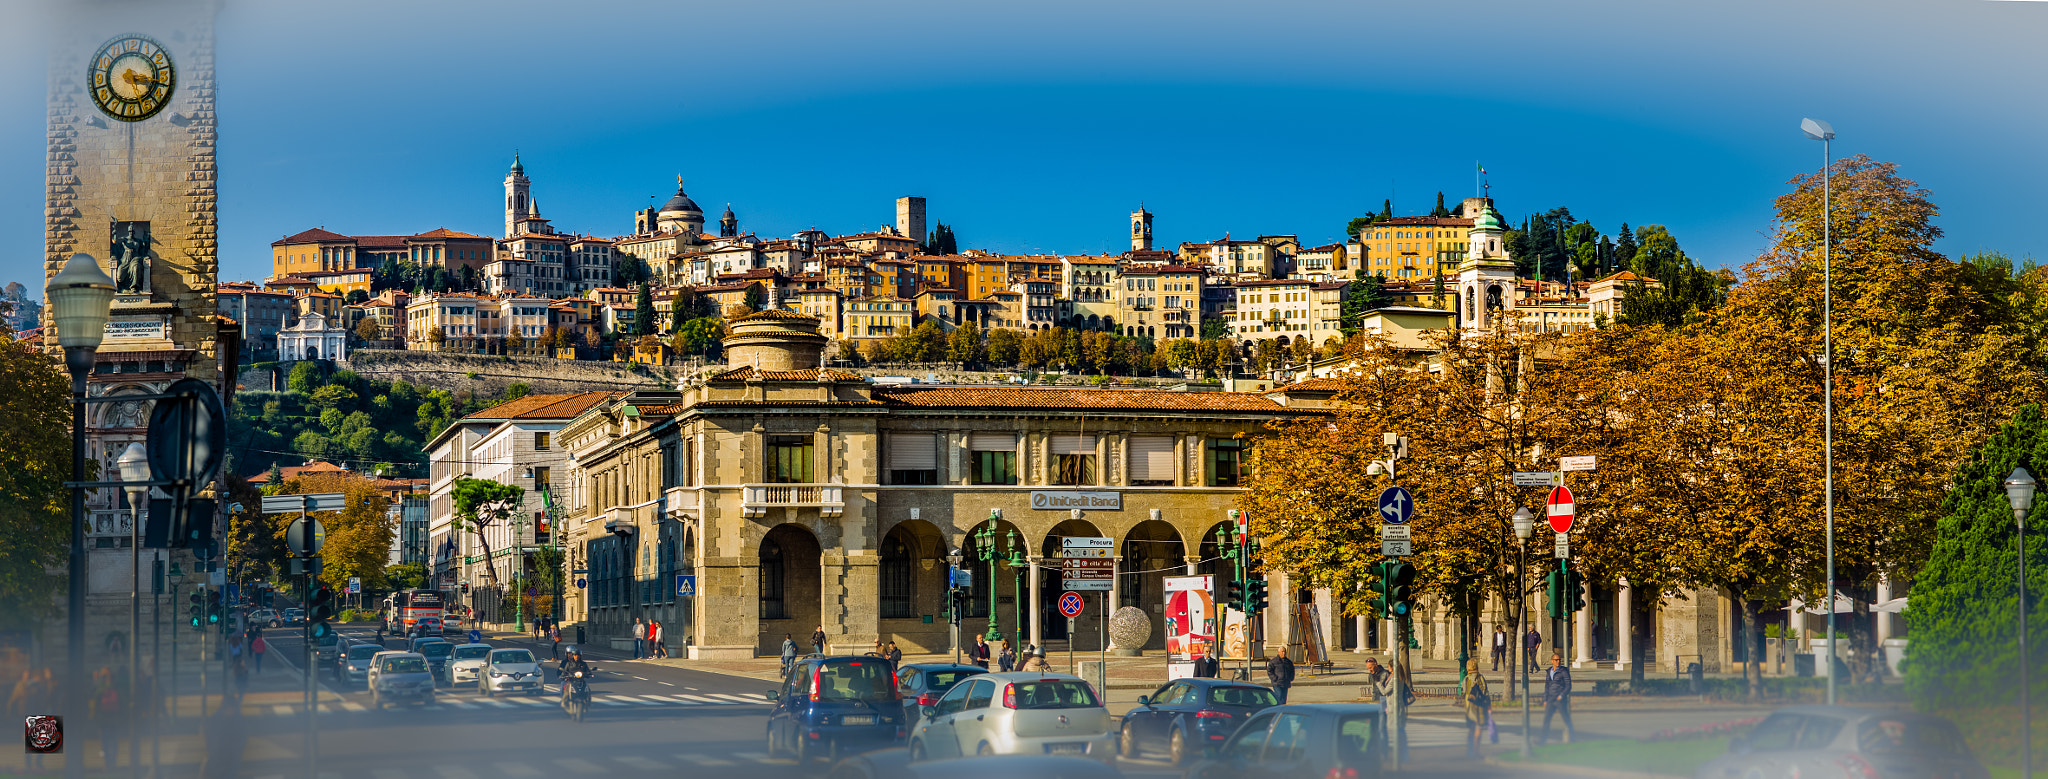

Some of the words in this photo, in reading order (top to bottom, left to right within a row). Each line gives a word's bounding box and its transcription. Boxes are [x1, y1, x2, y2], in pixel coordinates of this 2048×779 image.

[110, 44, 120, 55] 11
[125, 40, 137, 50] 12
[144, 44, 149, 54] 1
[98, 57, 110, 68] 10
[154, 54, 163, 64] 2
[95, 73, 102, 84] 9
[160, 70, 168, 82] 3
[100, 88, 107, 100] 8
[154, 88, 162, 98] 4
[112, 100, 119, 112] 7
[128, 104, 135, 115] 6
[144, 100, 152, 110] 5
[1049, 496, 1090, 506] UniCredit
[1091, 496, 1118, 506] Banca
